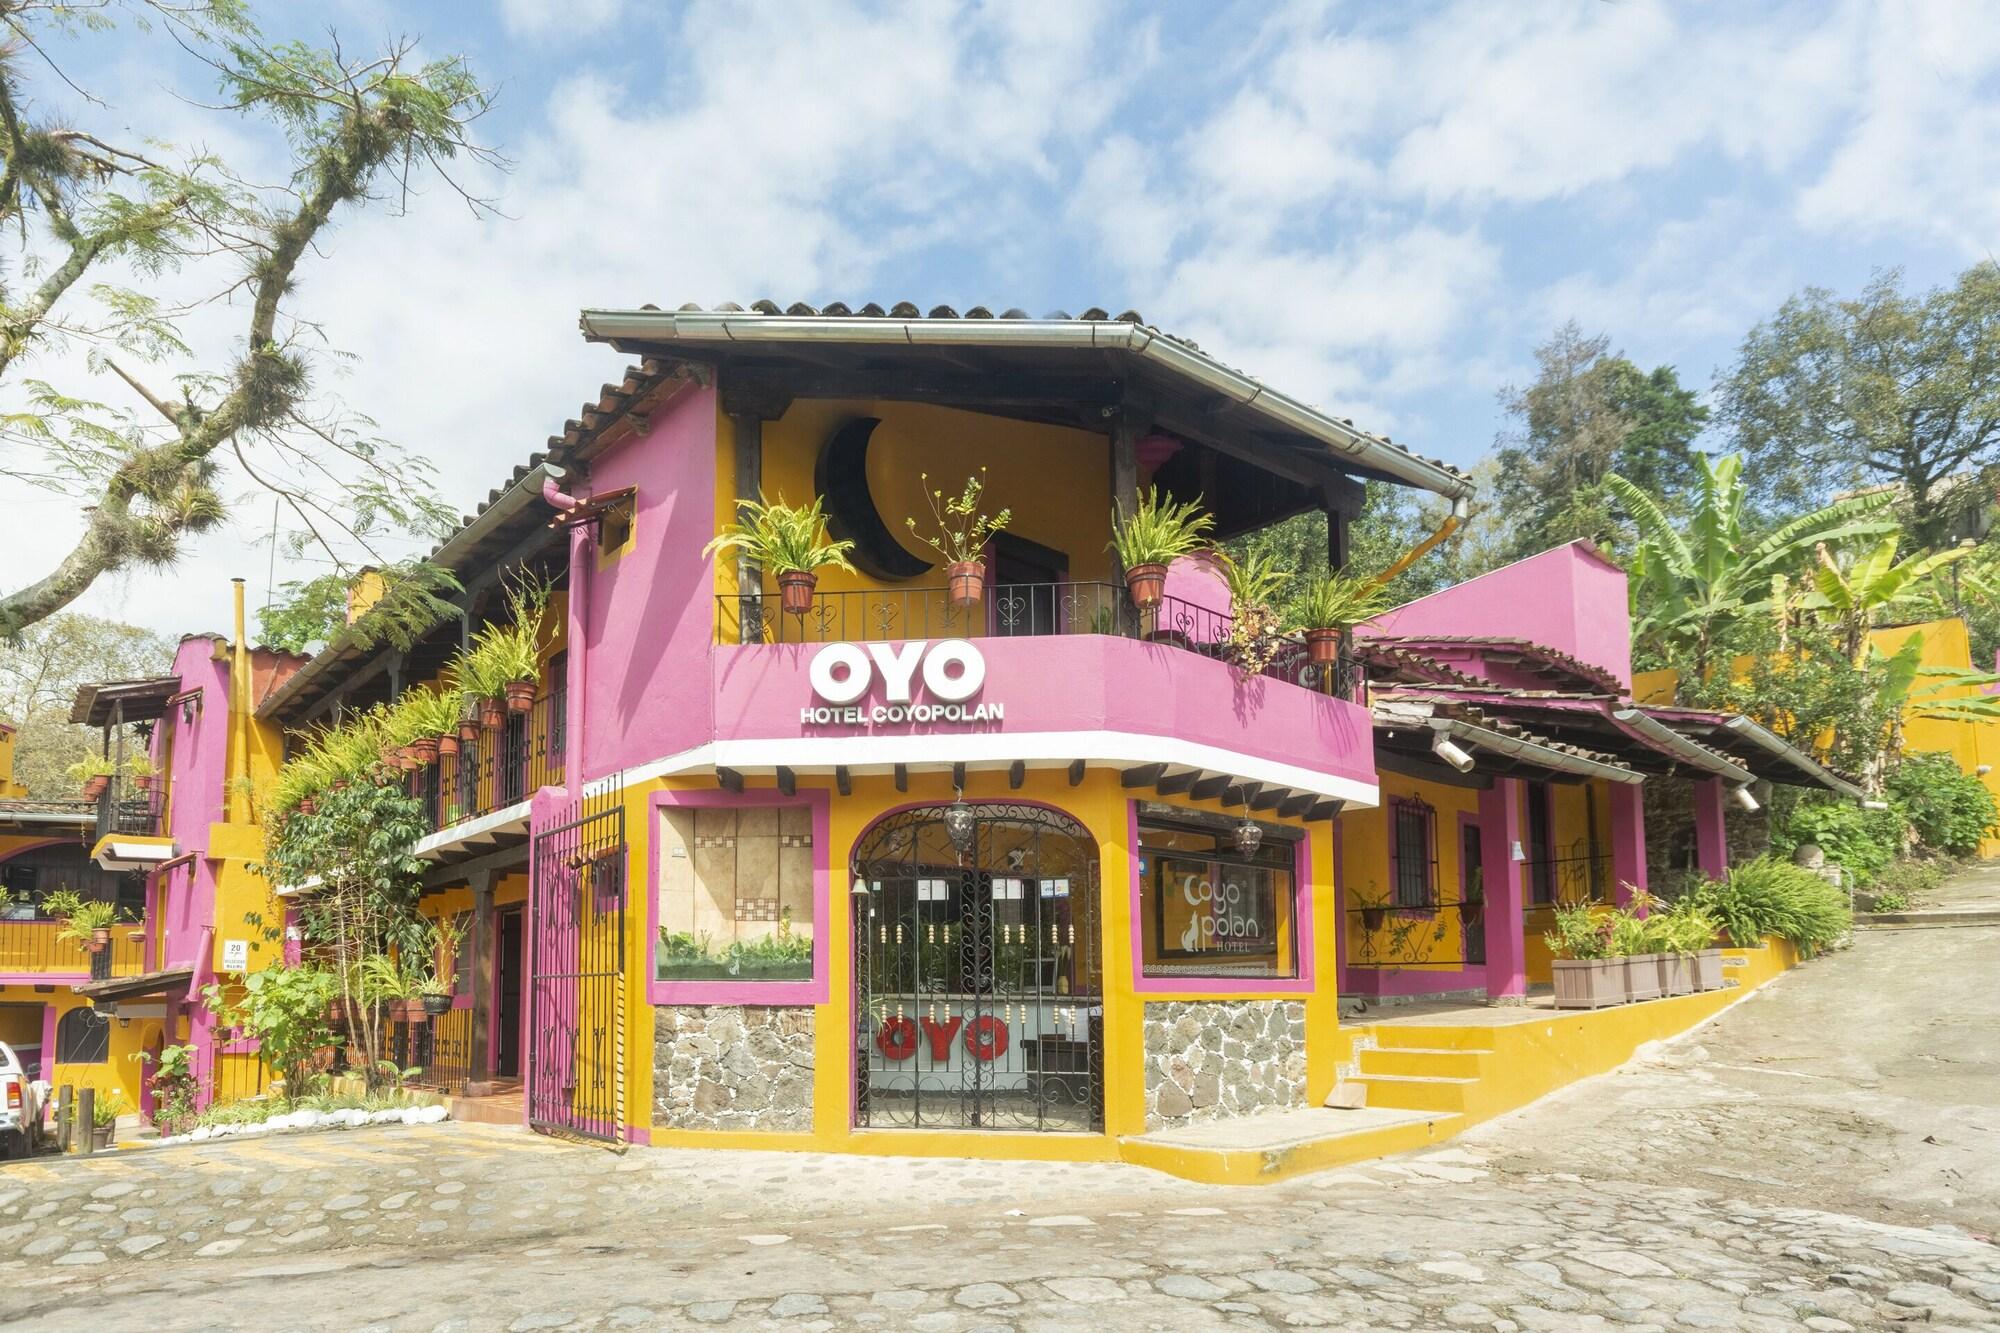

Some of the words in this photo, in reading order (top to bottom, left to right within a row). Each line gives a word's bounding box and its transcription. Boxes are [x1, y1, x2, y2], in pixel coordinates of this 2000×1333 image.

[809, 638, 986, 704] OYO
[800, 707, 869, 724] HOTEL
[871, 703, 1004, 723] COYOPOLAN
[1184, 875, 1240, 914] Coyo
[1202, 908, 1259, 952] polan
[1217, 941, 1250, 952] HOTEL
[876, 1015, 1009, 1061] OYO
